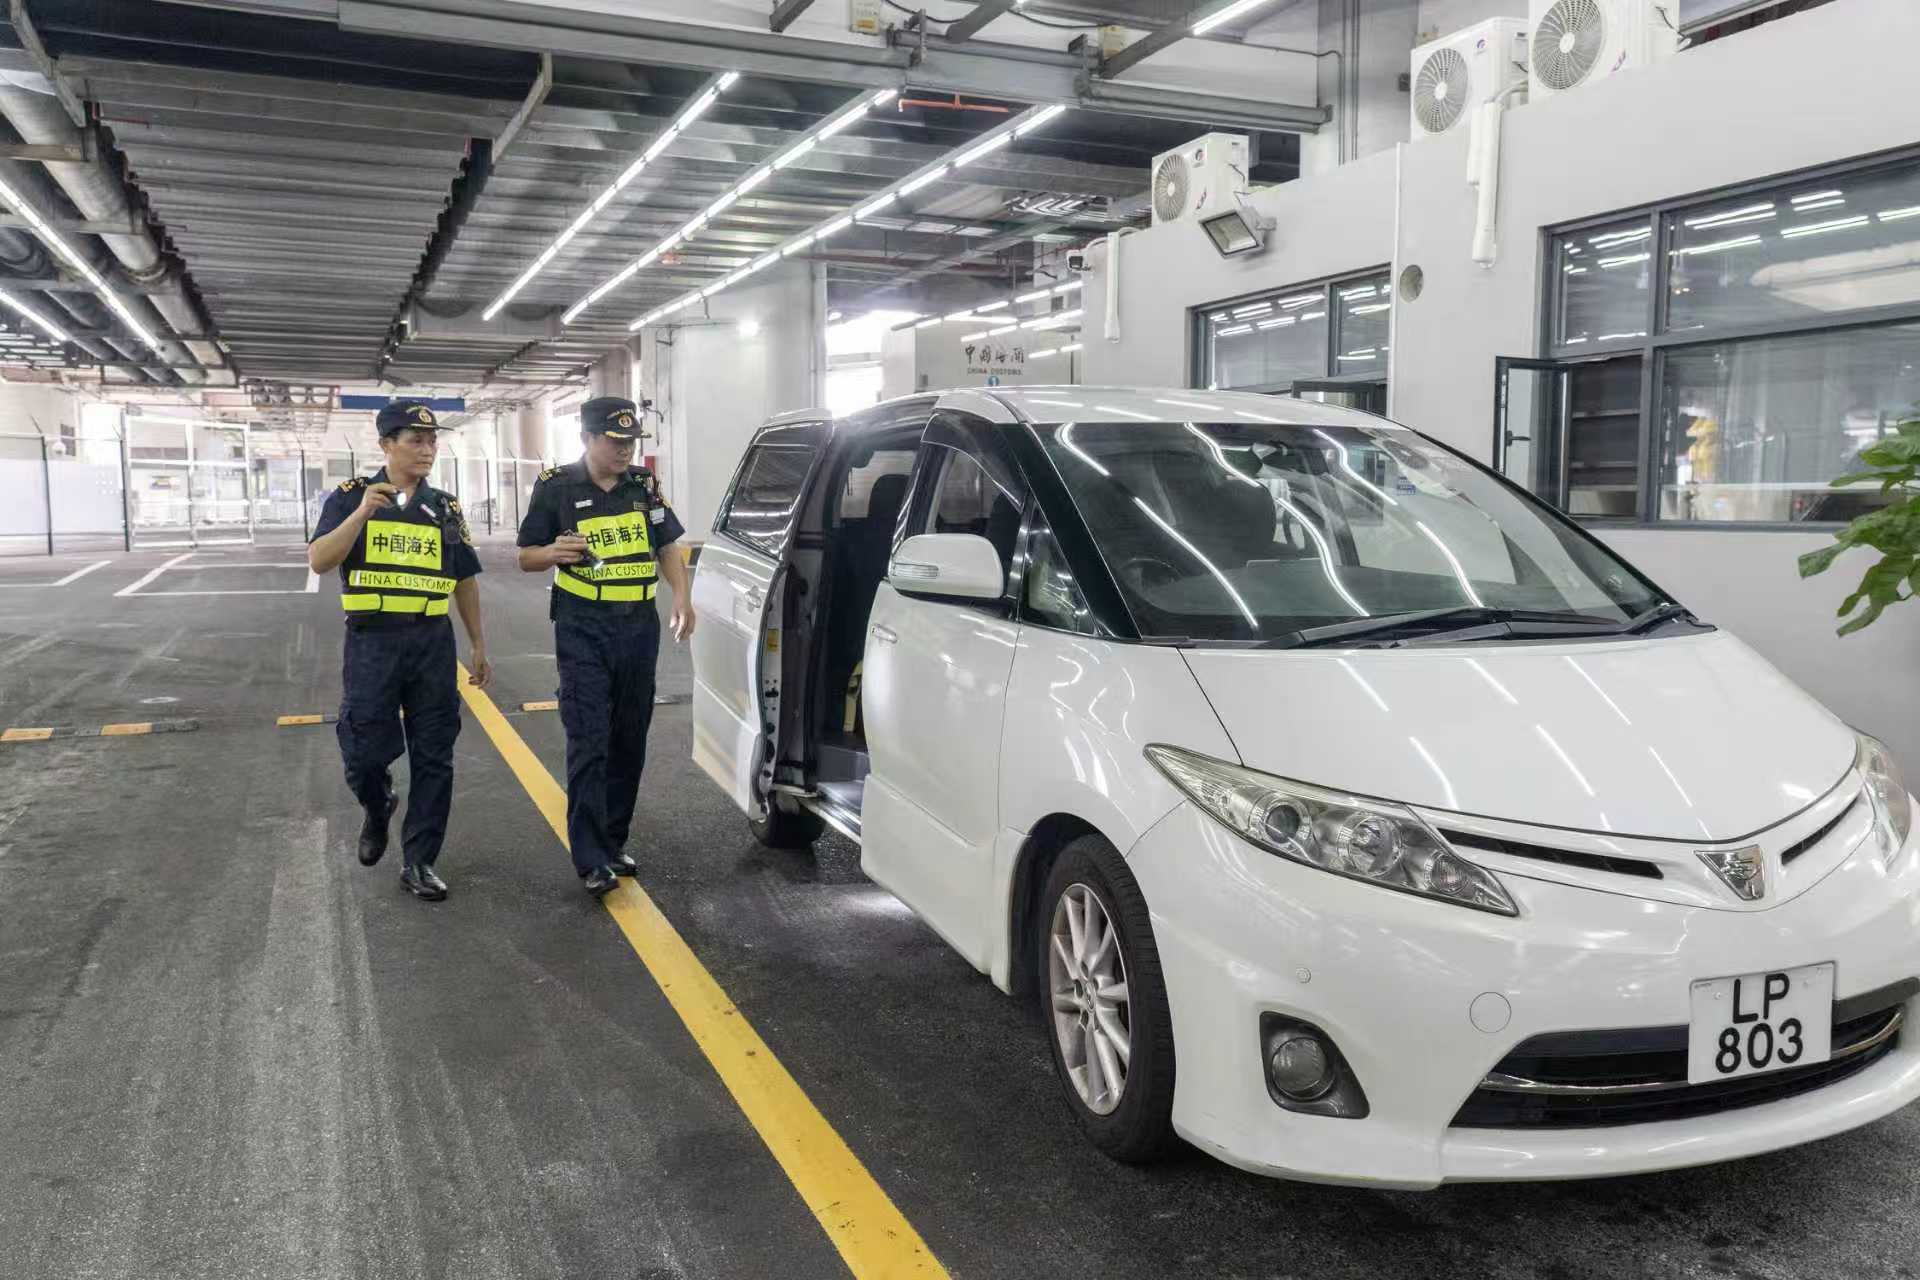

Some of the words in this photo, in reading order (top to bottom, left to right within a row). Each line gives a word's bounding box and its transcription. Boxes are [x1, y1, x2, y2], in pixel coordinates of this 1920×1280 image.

[372, 533, 438, 557] 中国海关
[586, 523, 645, 549] 中国海关
[357, 572, 392, 585] HINA
[395, 575, 451, 591] CUSTOMS
[615, 564, 654, 577] CUSTOM
[1732, 972, 1791, 1024] LP
[1715, 1017, 1804, 1074] 803
